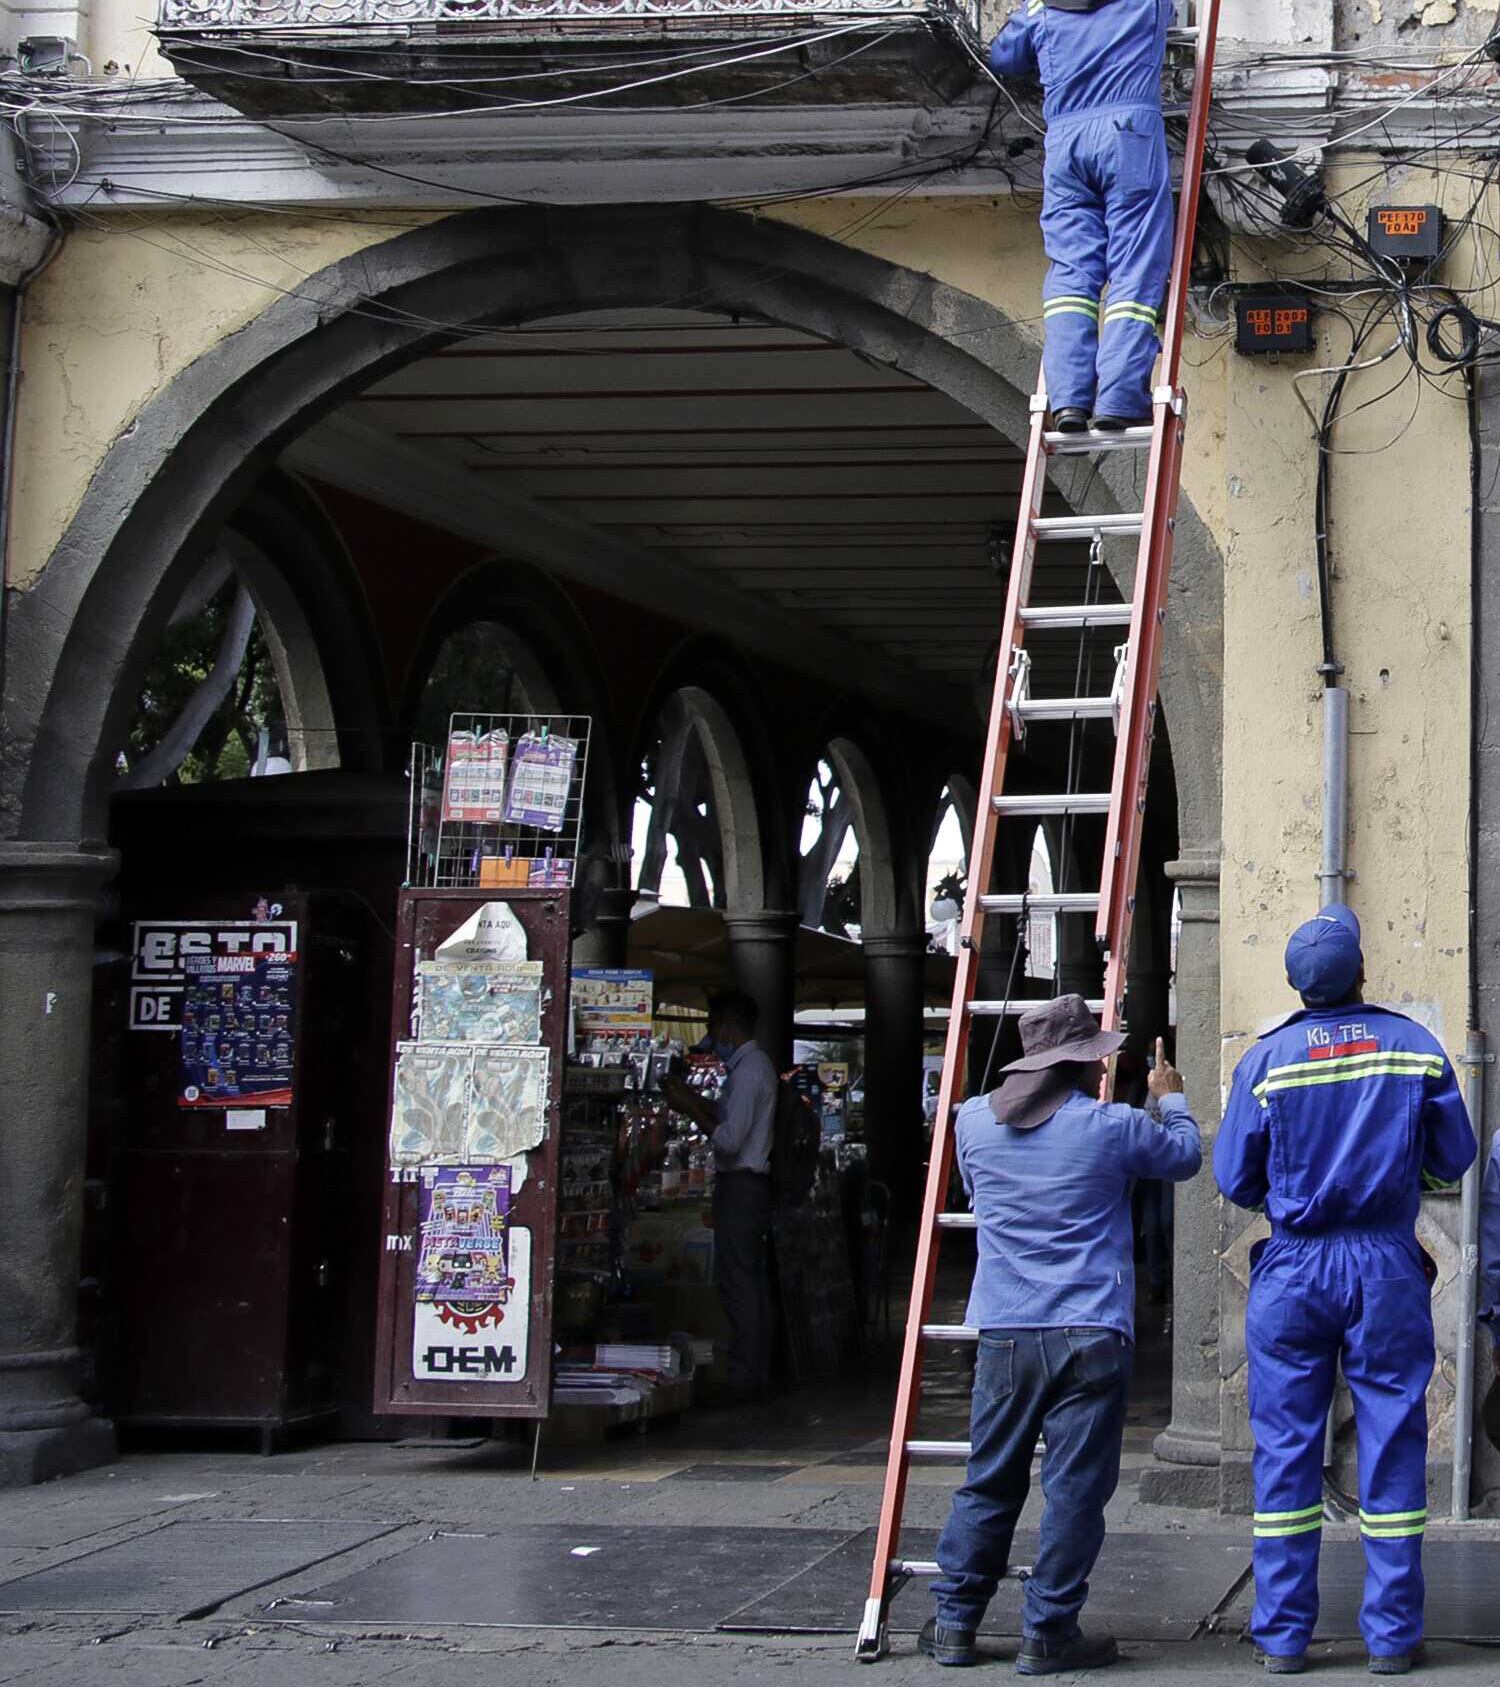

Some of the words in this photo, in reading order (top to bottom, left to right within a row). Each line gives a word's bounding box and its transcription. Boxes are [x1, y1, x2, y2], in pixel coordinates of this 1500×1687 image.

[217, 956, 256, 973] MARVEL
[140, 997, 171, 1021] DE
[422, 1345, 516, 1373] OEM
